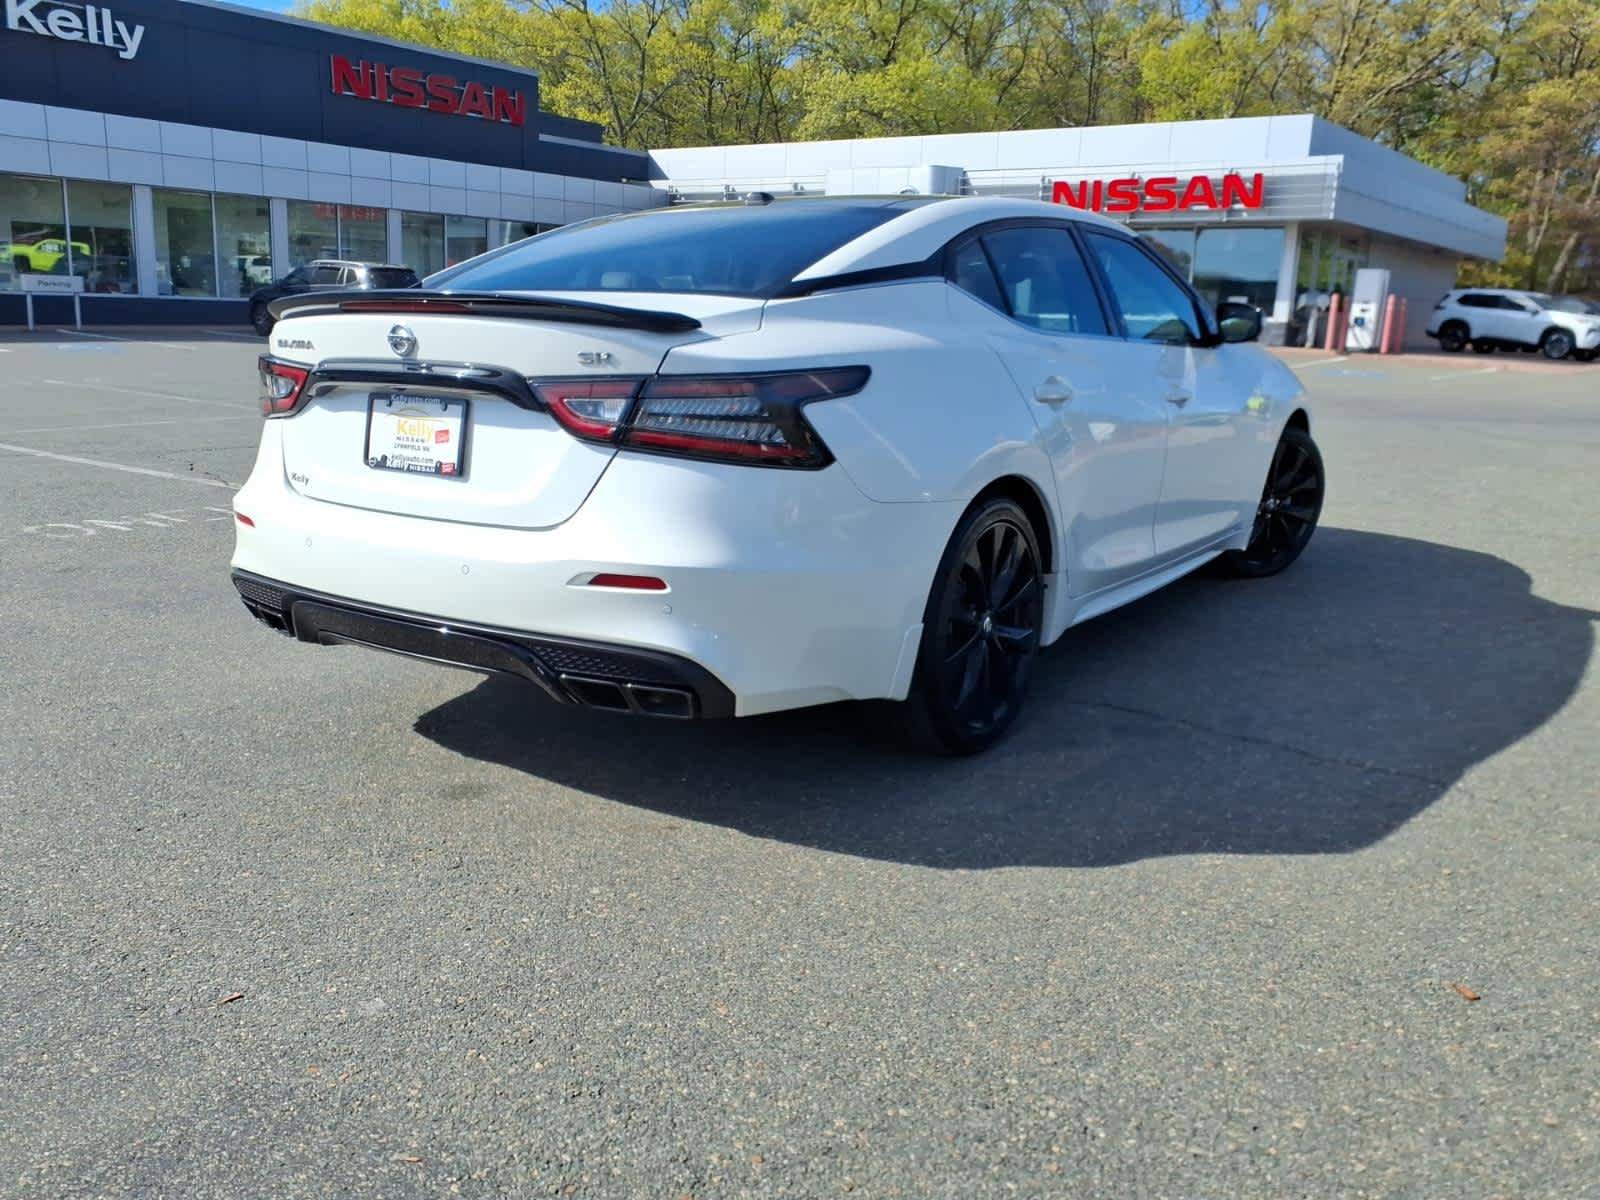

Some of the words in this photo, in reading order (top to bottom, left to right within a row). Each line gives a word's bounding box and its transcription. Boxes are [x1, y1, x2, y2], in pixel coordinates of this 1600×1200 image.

[5, 0, 145, 60] Kelly
[330, 54, 526, 127] NISSAN
[1053, 172, 1265, 213] NISSAN
[397, 419, 433, 442] Kelly
[386, 458, 410, 472] Kelly
[409, 464, 436, 473] NISSAN
